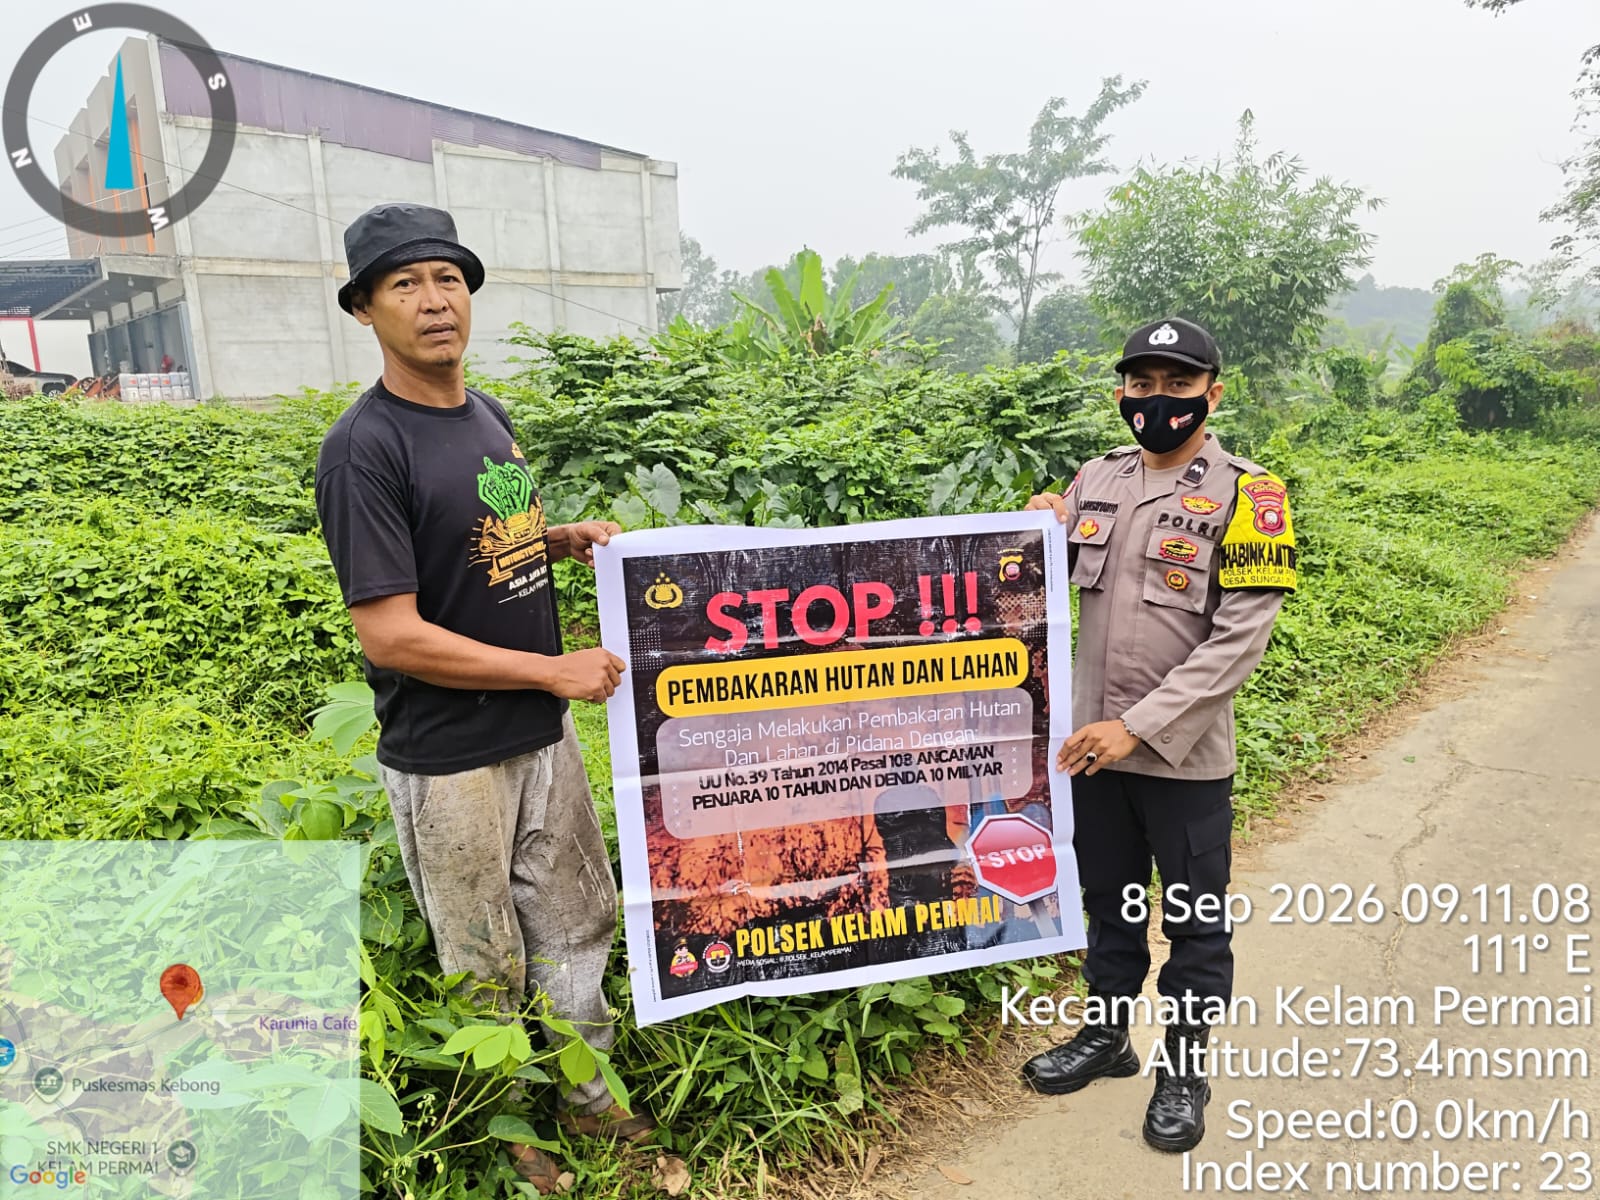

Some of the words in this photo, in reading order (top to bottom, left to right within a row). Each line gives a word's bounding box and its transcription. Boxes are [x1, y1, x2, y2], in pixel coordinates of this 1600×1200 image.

[1158, 513, 1219, 537] POLRI
[1224, 576, 1247, 585] DESA
[704, 581, 896, 654] STOP
[917, 571, 983, 637] !!!
[668, 667, 818, 705] PEMBAKARAN
[826, 660, 895, 693] HUTAN
[902, 656, 943, 685] DAN
[951, 651, 1019, 681] LAHAN
[679, 723, 752, 748] Sengaja
[758, 715, 852, 740] Melakukan
[858, 706, 964, 730] Pembakaran
[970, 700, 1021, 719] Hutan
[699, 773, 722, 790] UU
[771, 765, 815, 782] Tahun
[818, 758, 848, 777] 2014
[851, 754, 887, 772] Pasal
[916, 745, 995, 766] ANCAMAN
[725, 749, 759, 767] Dan
[766, 743, 818, 762] Lahan
[825, 737, 840, 755] di
[846, 735, 904, 753] Pidana
[692, 790, 763, 811] PENJARA
[765, 786, 780, 802] 10
[782, 778, 837, 799] TAHUN
[840, 775, 871, 792] DAN
[875, 770, 927, 788] DENDA
[930, 767, 944, 783] 10
[947, 762, 1003, 781] MILYAR
[988, 843, 1047, 869] STOP
[735, 919, 823, 958] POLSEK
[830, 905, 907, 945] KELAM
[915, 895, 1001, 933] PERMAI
